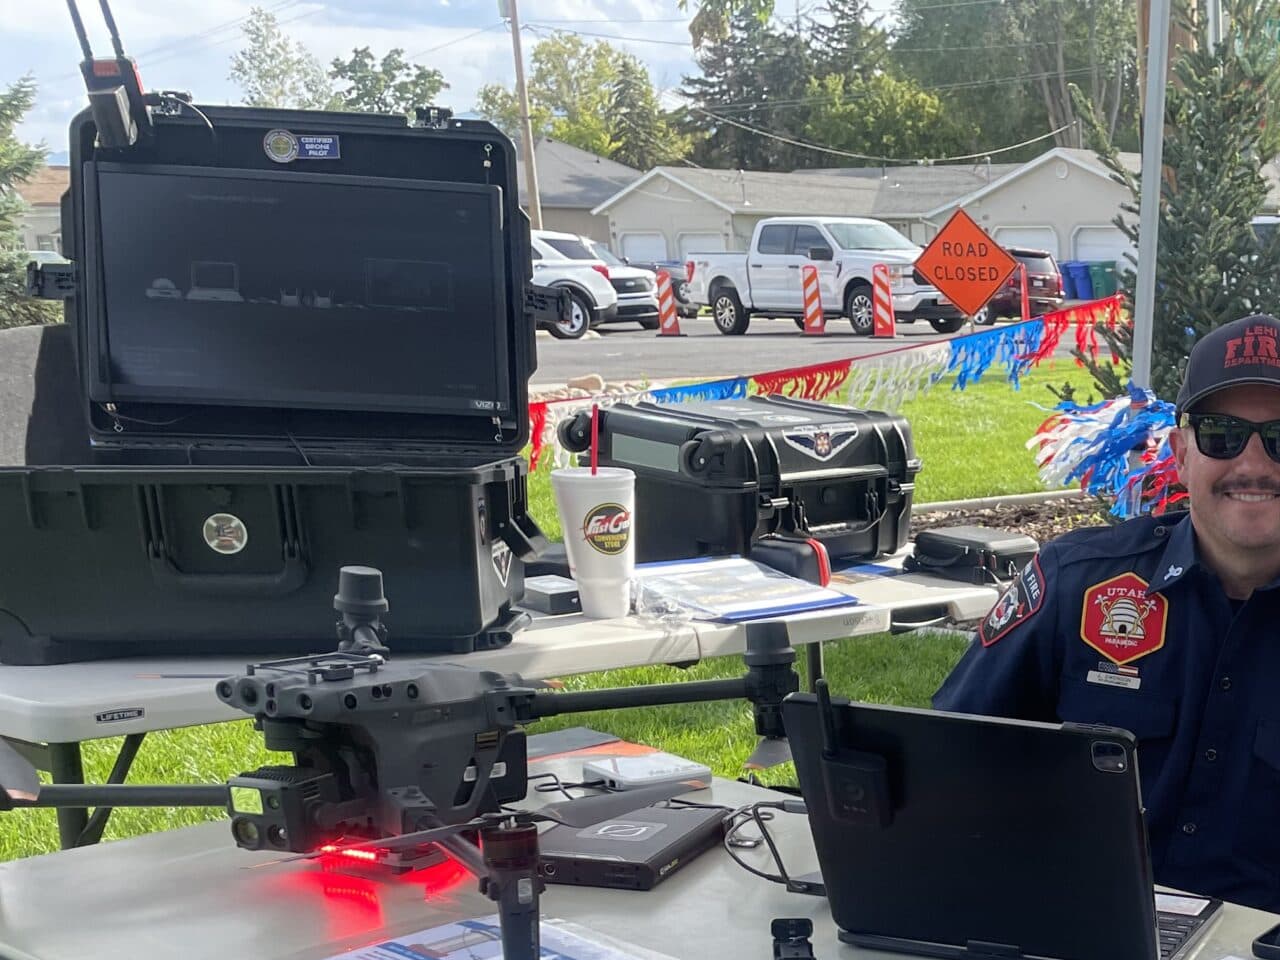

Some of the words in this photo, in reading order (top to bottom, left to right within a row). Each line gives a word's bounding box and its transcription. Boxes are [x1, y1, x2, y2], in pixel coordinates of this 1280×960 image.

[942, 241, 988, 257] ROAD
[934, 265, 999, 281] CLOSED
[1245, 326, 1278, 337] LEHI
[1027, 573, 1041, 600] FIRE
[1107, 587, 1147, 600] UTAH
[1104, 637, 1138, 648] PARAMEDIC
